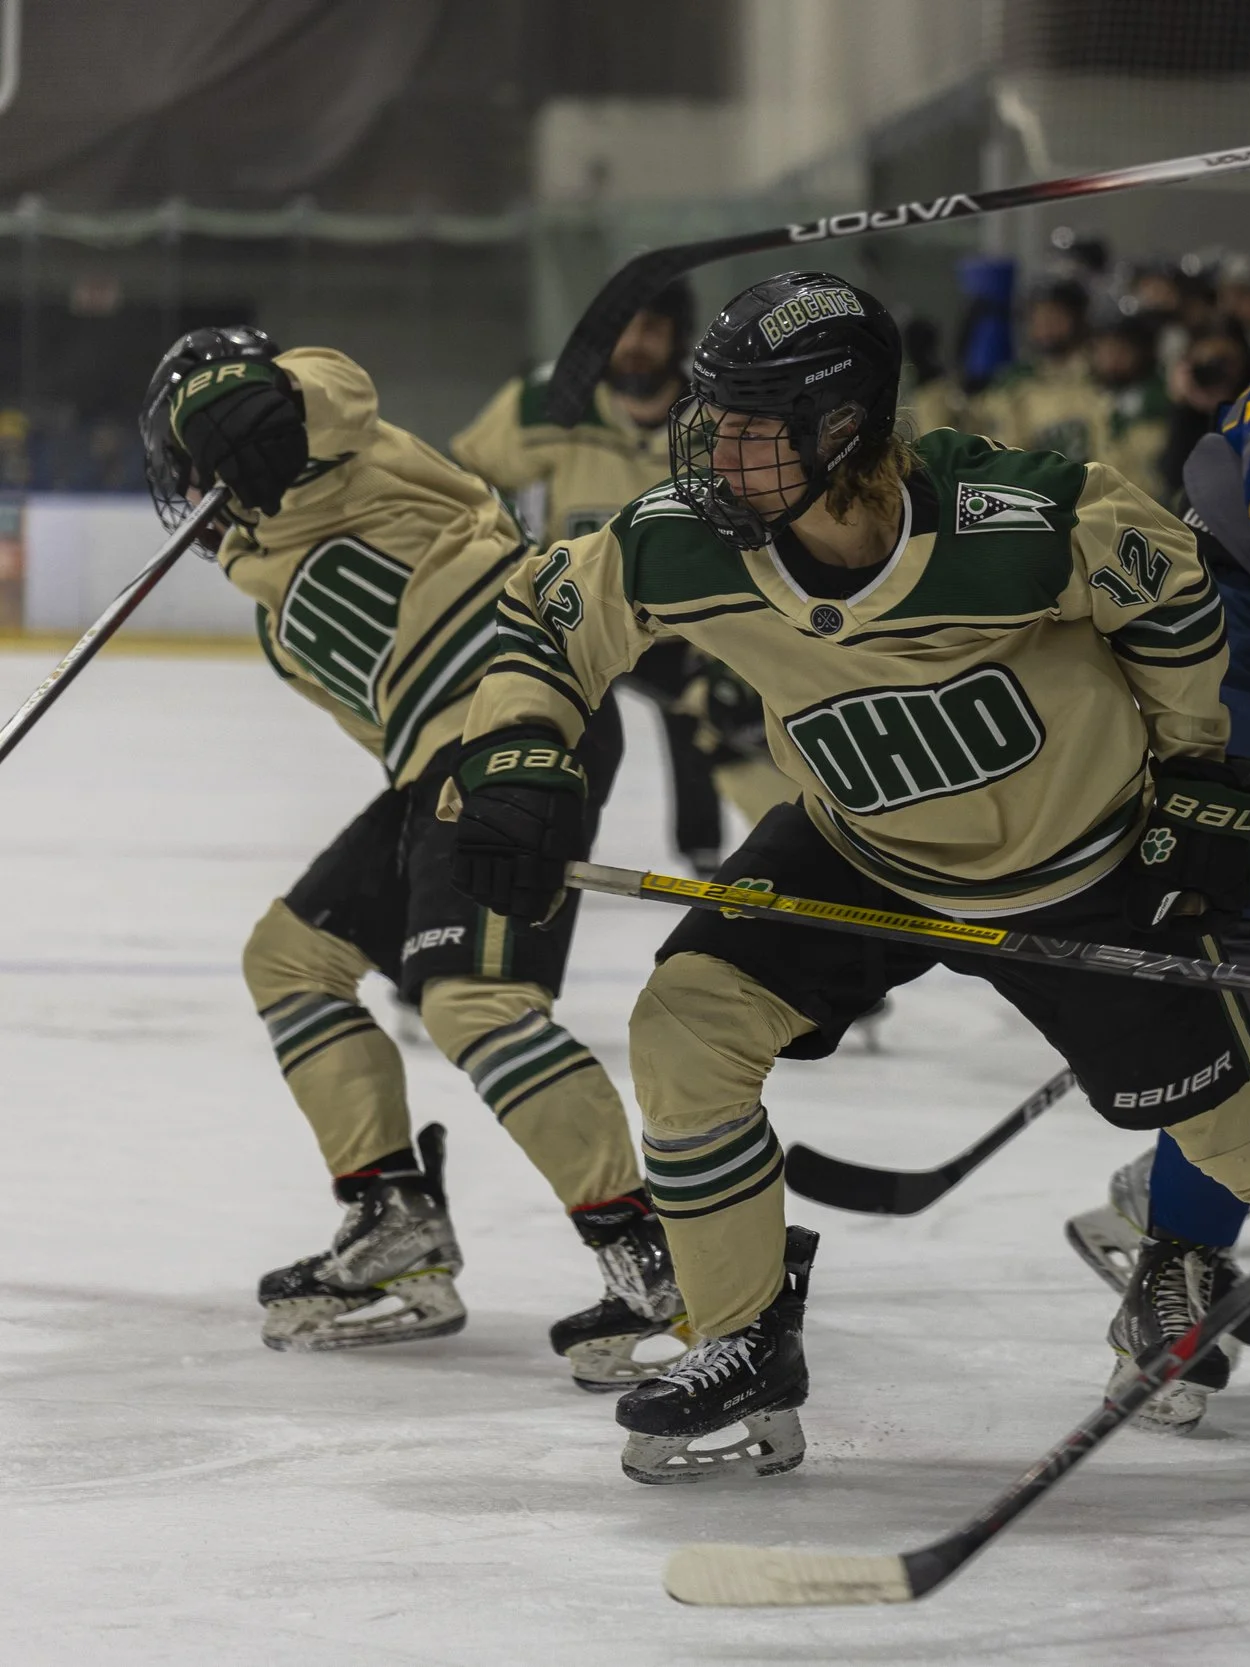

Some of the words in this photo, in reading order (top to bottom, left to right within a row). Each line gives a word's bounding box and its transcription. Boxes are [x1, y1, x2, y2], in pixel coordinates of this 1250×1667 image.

[786, 193, 981, 243] VAPOR
[759, 288, 867, 350] BOBCATS
[804, 358, 853, 385] BAUER
[827, 434, 861, 472] BAUER
[1088, 527, 1173, 608] 12
[533, 547, 584, 655] 12
[783, 664, 1045, 815] OHIO
[1112, 1050, 1234, 1109] BAUER
